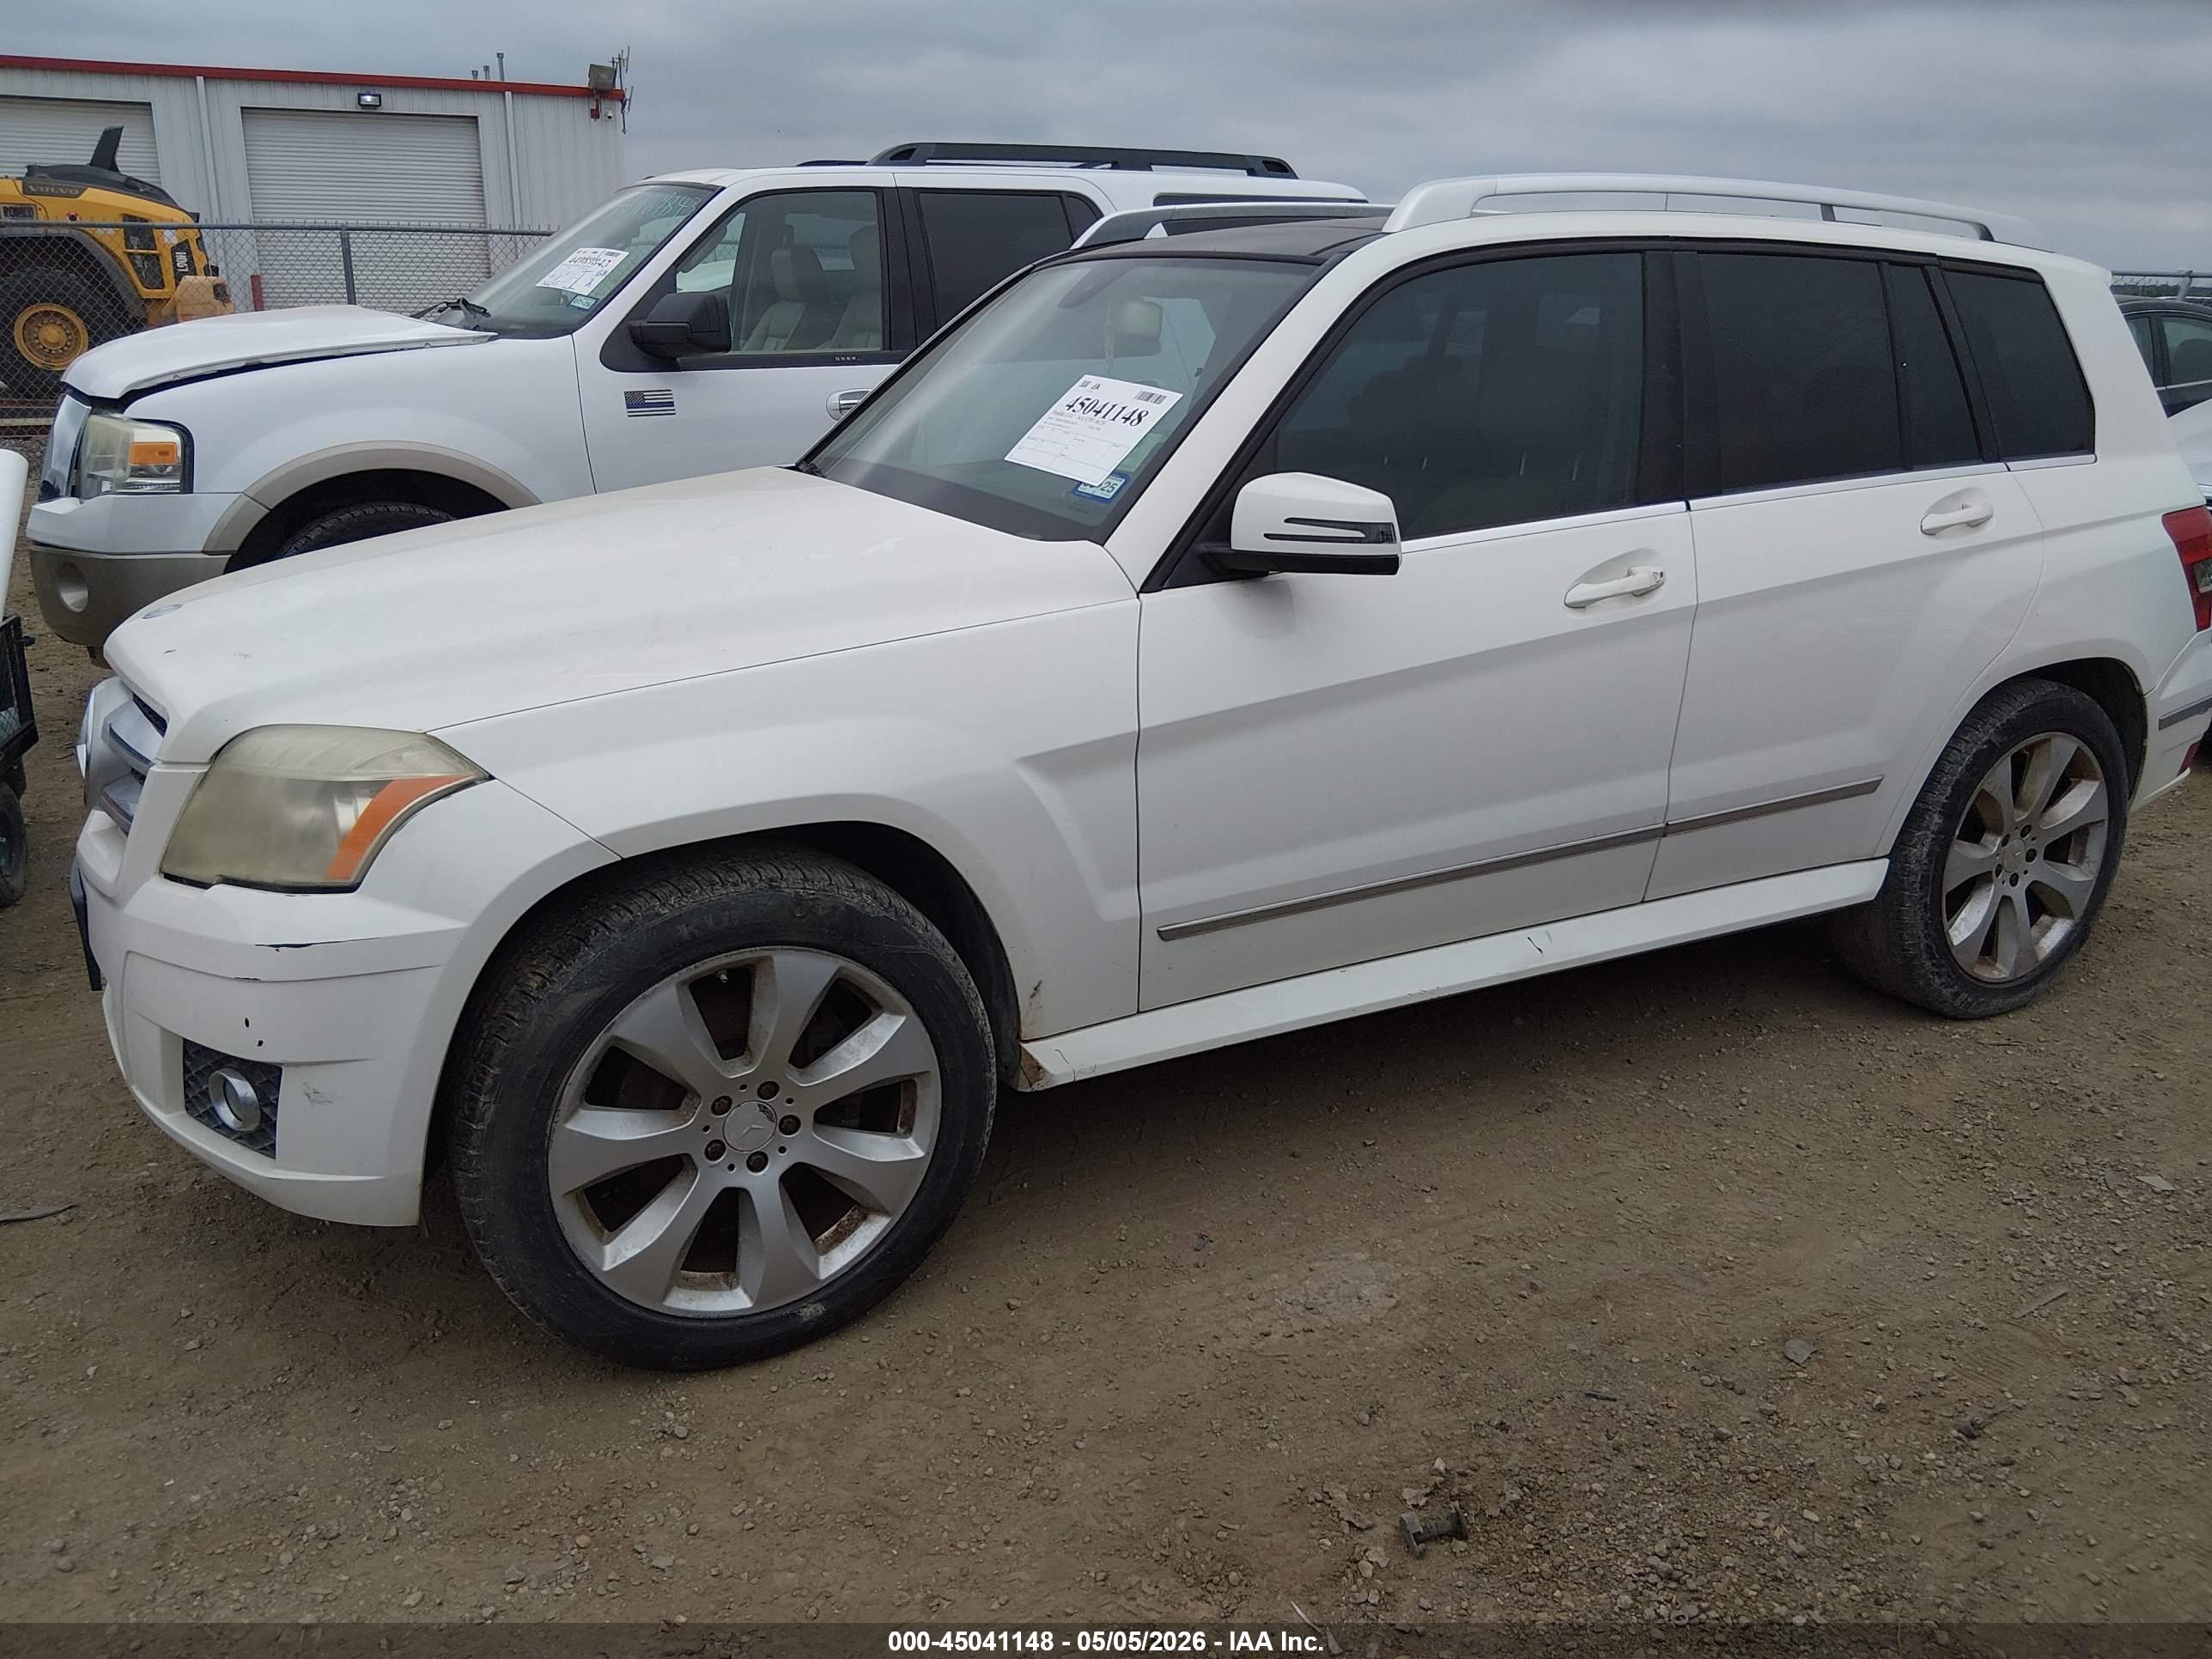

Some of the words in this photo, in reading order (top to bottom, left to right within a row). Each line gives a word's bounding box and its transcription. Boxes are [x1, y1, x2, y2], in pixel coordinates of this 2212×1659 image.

[28, 185, 80, 195] VOLVO
[174, 252, 190, 272] L90H
[1066, 396, 1149, 427] 45041148
